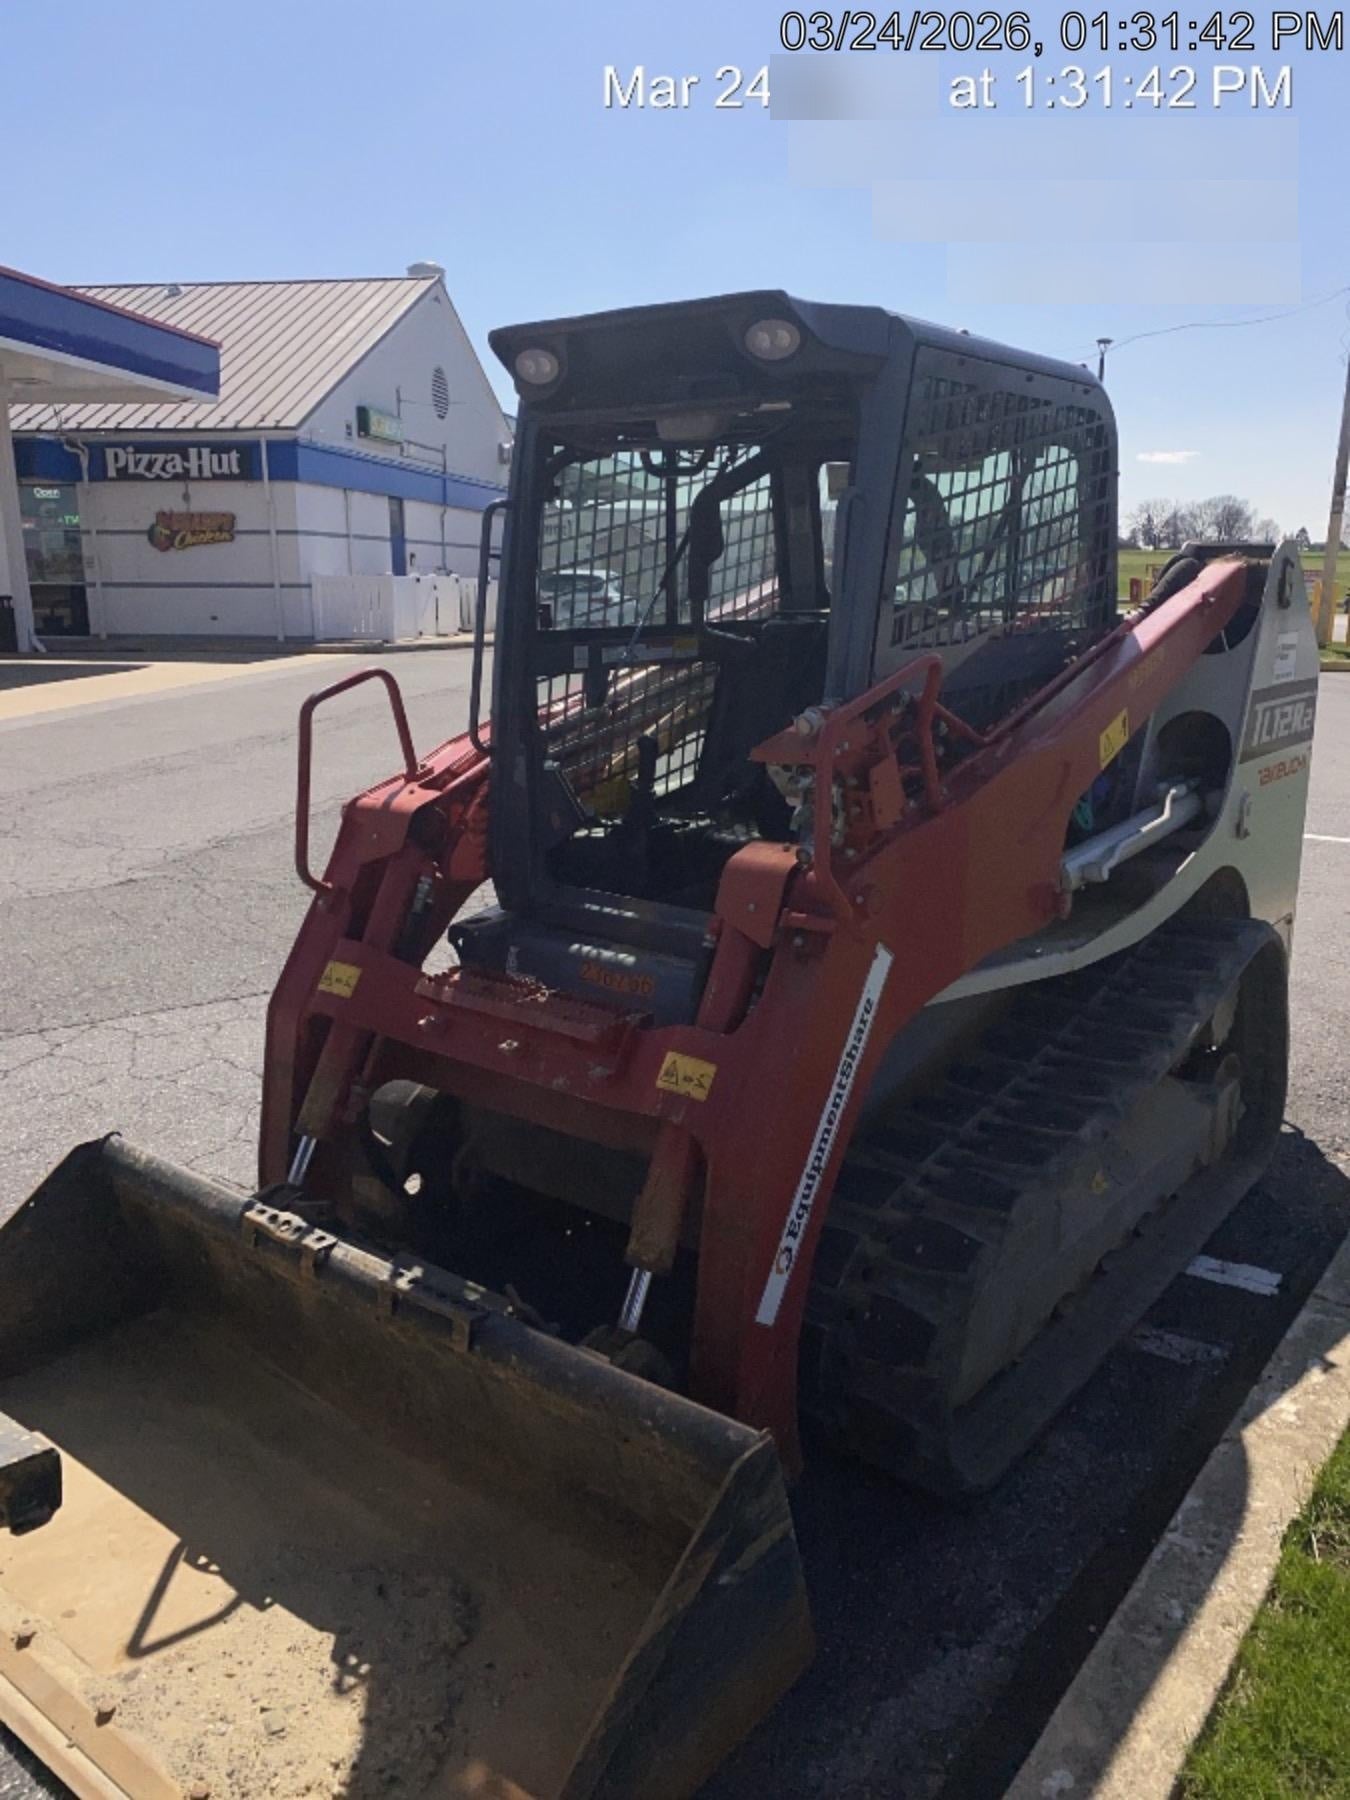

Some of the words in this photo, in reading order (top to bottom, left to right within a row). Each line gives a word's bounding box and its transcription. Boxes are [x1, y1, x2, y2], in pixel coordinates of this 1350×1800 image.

[105, 446, 184, 479] Pizza
[184, 447, 241, 478] Hut
[785, 996, 874, 1241] EquipmentShare
